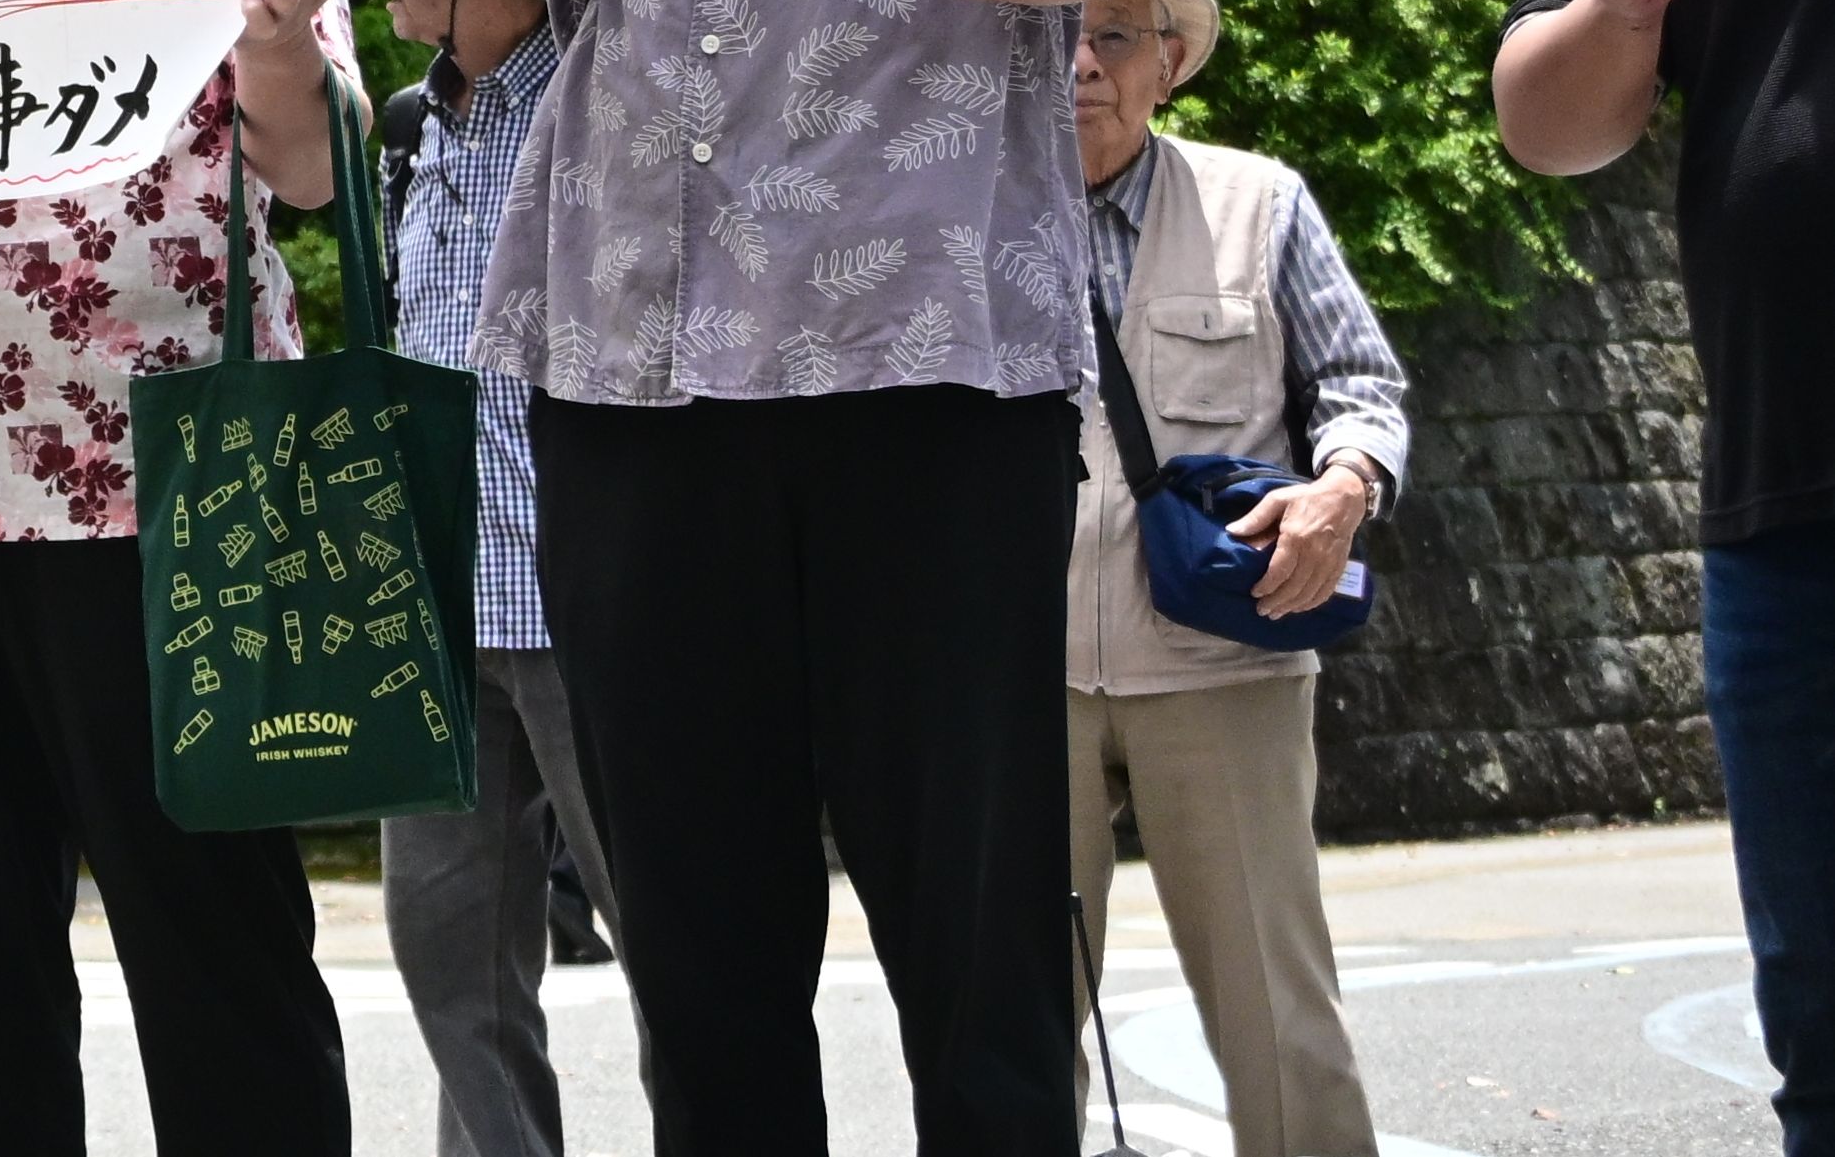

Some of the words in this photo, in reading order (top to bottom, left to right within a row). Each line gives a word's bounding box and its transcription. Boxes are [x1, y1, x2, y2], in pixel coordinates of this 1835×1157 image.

[249, 711, 354, 746] JAMESON
[256, 750, 290, 762] IRISH
[293, 745, 349, 759] WHISKEY
